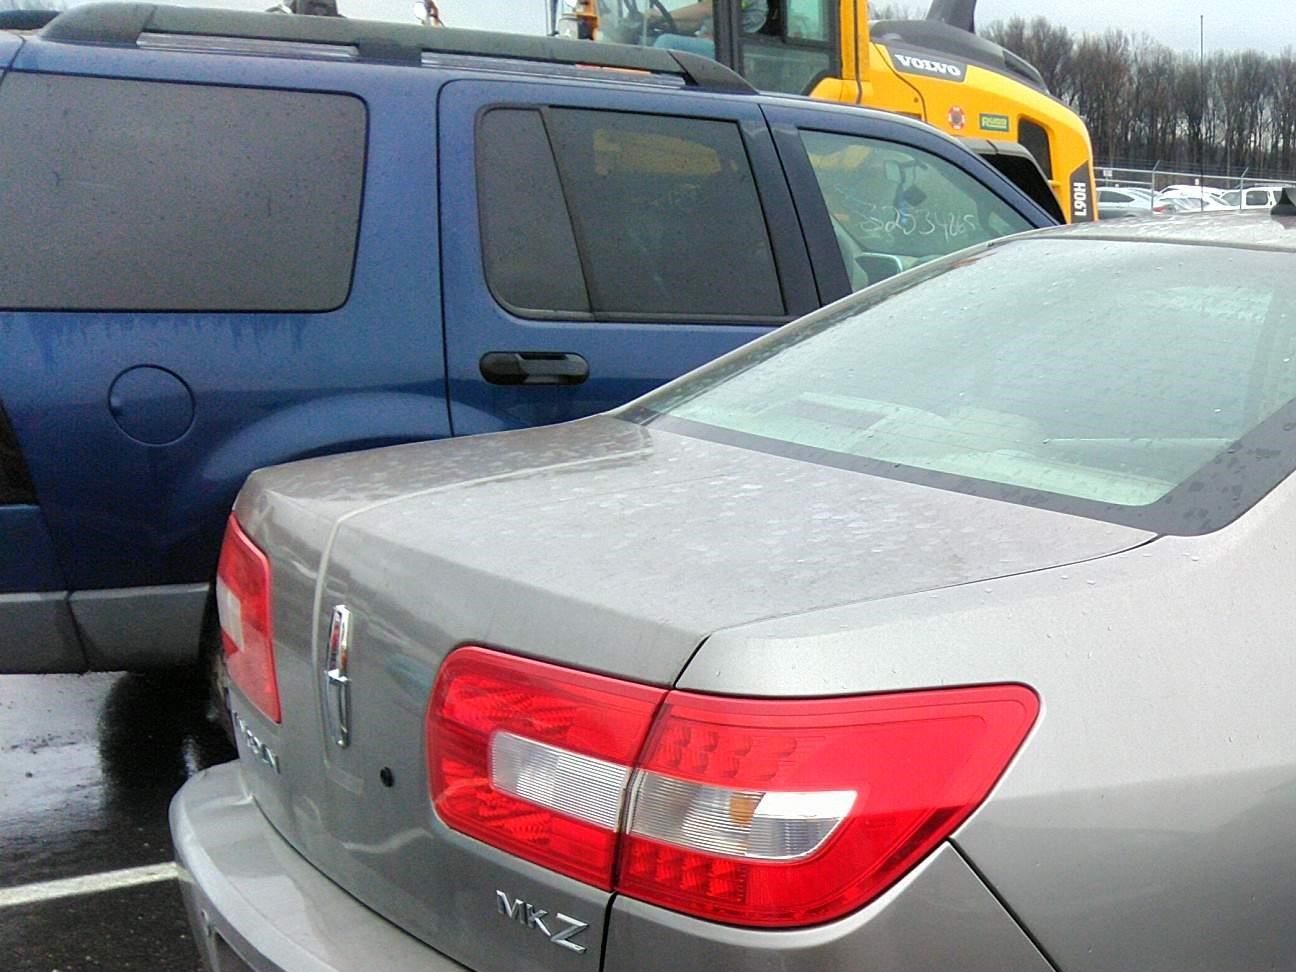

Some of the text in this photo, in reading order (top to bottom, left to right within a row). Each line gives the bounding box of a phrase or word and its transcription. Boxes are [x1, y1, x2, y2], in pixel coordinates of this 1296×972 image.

[894, 53, 961, 77] VOLVO
[1072, 181, 1088, 217] L90H
[496, 889, 590, 955] MKZ
